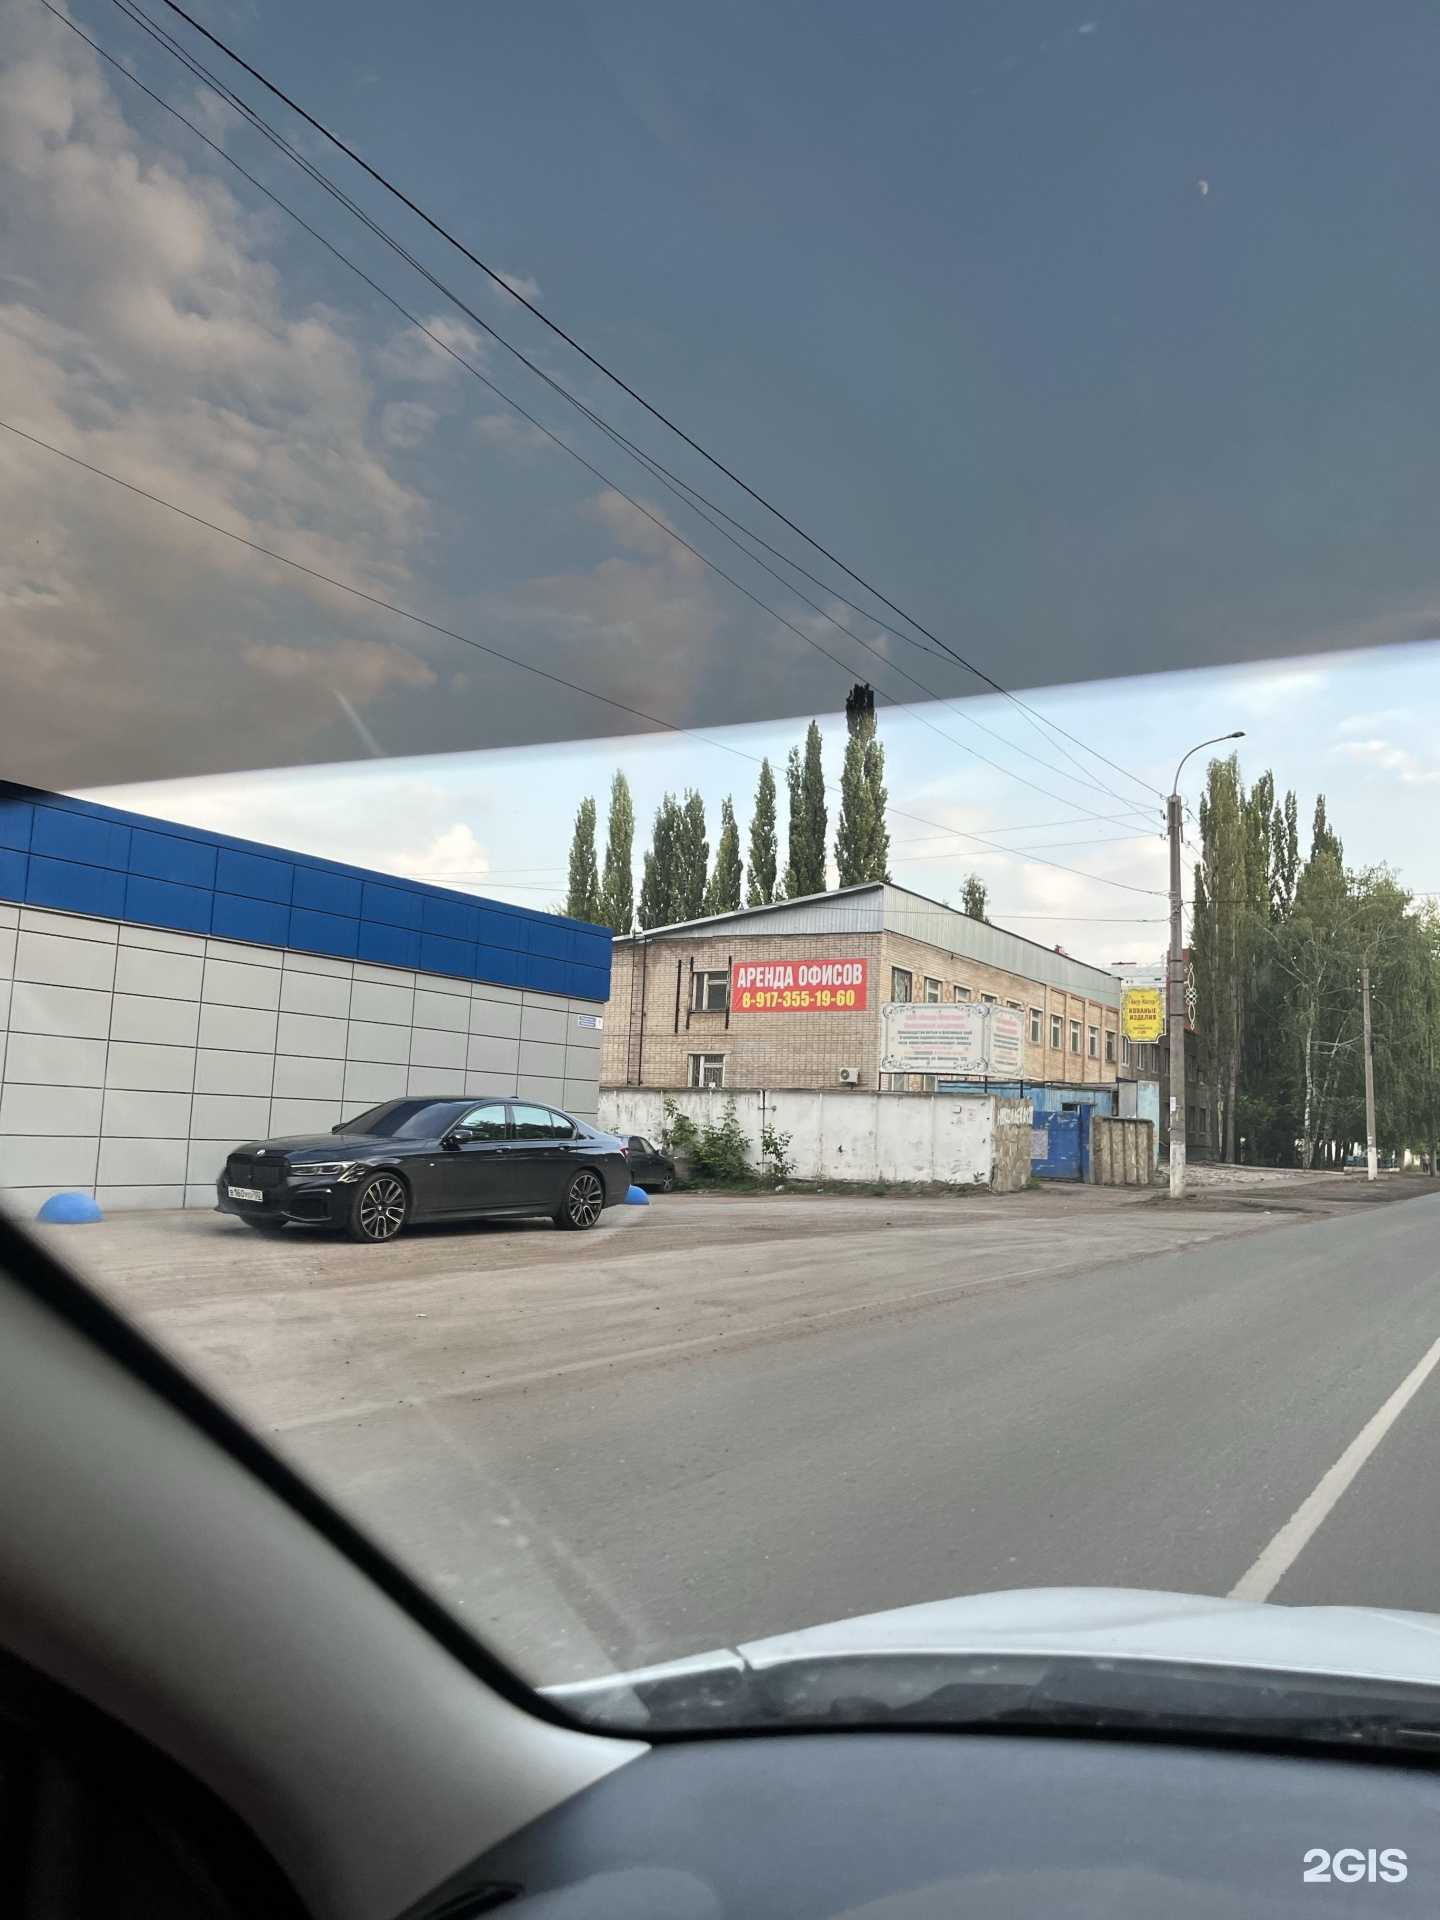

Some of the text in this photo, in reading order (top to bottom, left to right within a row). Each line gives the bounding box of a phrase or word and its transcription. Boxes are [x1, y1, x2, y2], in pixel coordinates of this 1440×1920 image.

[737, 963, 863, 989] АРЕНДА ОФИСОВ
[742, 989, 855, 1008] 8-917-355-19-60
